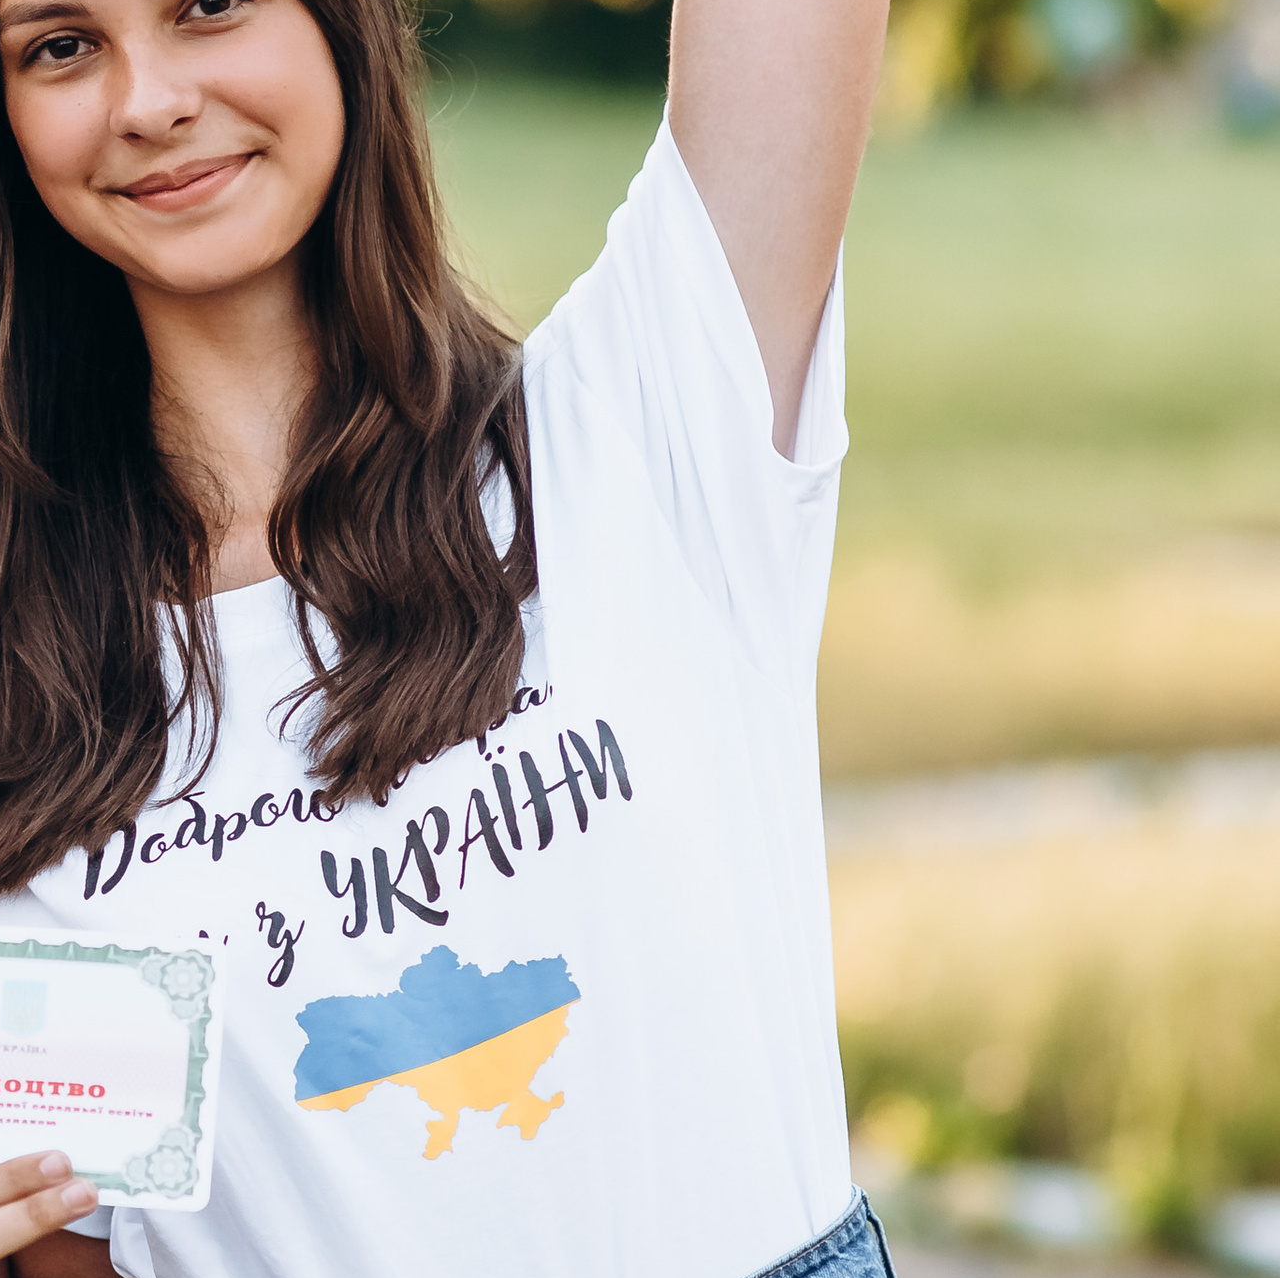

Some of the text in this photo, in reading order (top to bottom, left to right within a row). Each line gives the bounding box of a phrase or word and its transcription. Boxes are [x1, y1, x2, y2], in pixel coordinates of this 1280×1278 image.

[255, 901, 306, 988] з
[320, 719, 633, 939] УКРАЇНИ
[107, 1108, 154, 1119] освіти
